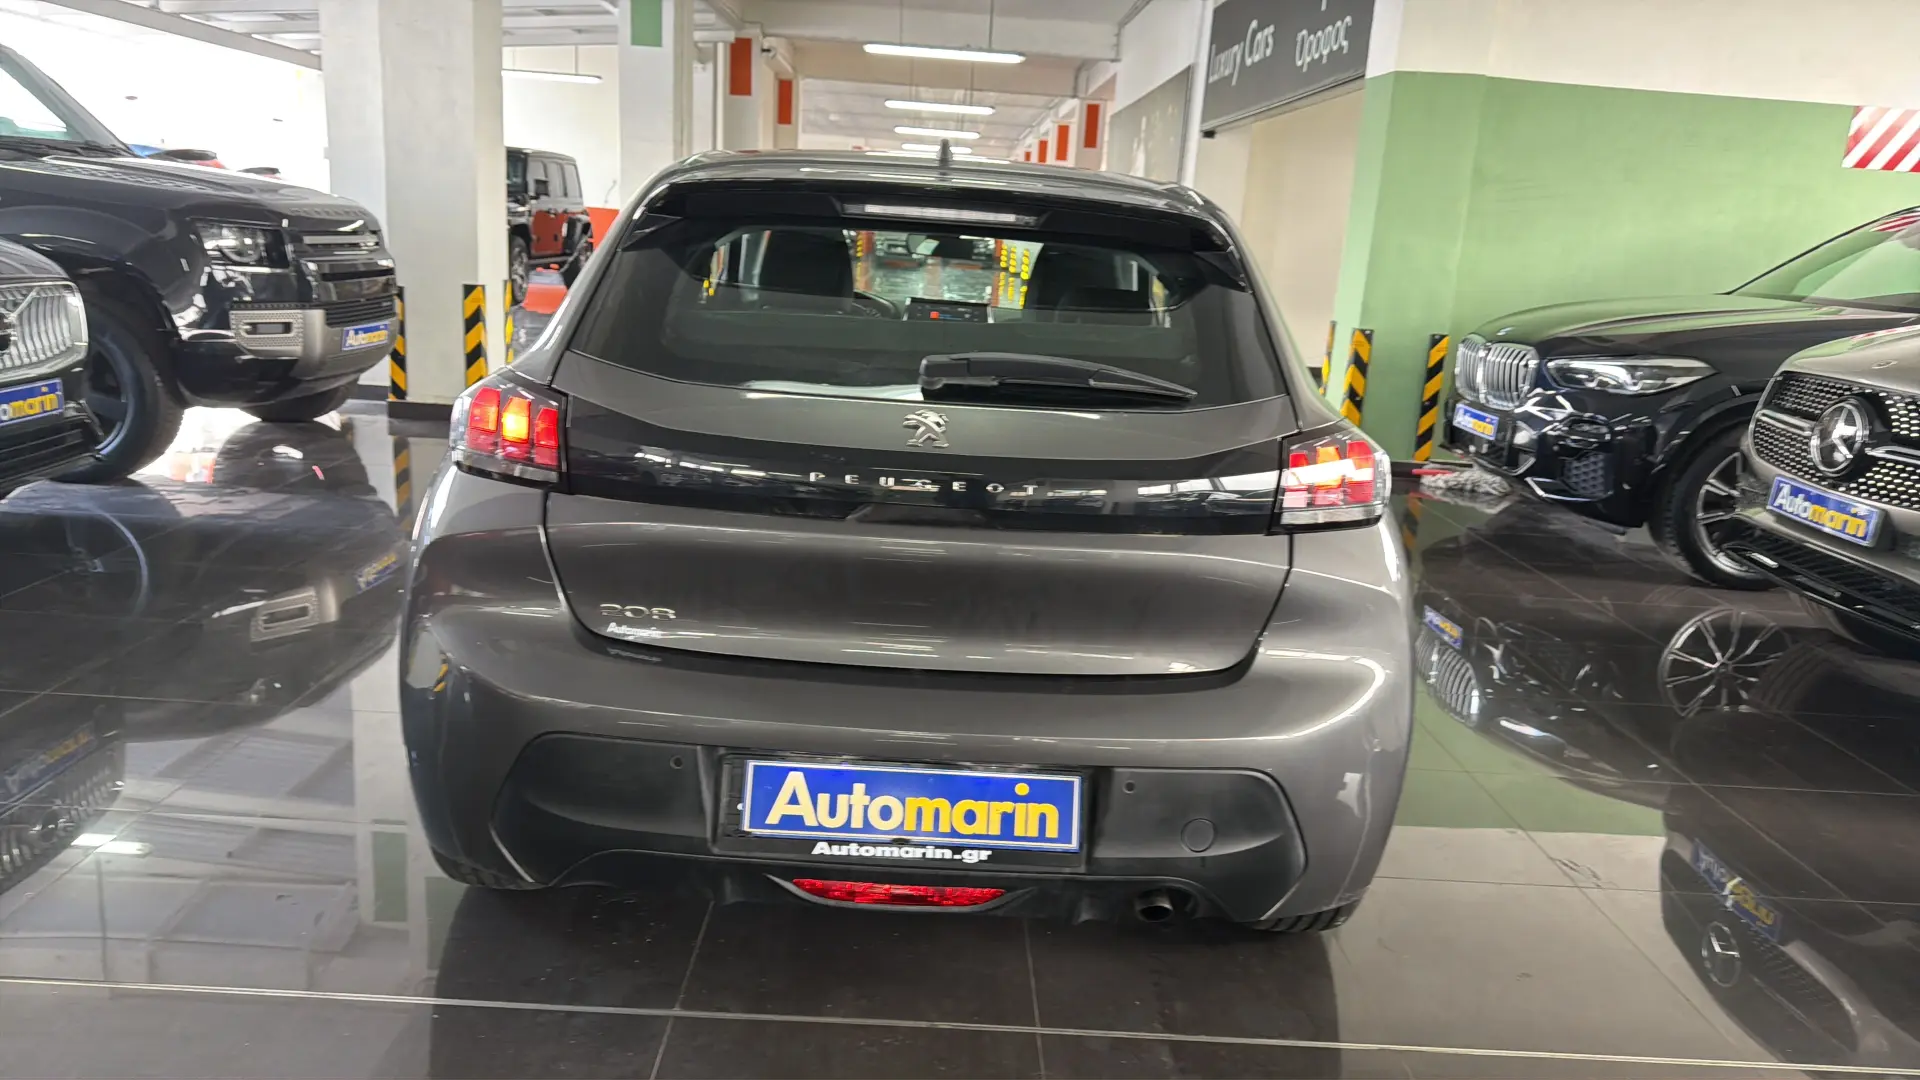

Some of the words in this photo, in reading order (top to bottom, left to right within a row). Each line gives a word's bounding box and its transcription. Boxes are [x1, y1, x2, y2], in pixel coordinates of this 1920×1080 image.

[1208, 41, 1244, 86] Luxury
[1245, 19, 1275, 67] Cars
[600, 603, 677, 621] 208
[764, 771, 1060, 839] Automarin
[811, 841, 993, 864] Automarin.gr
